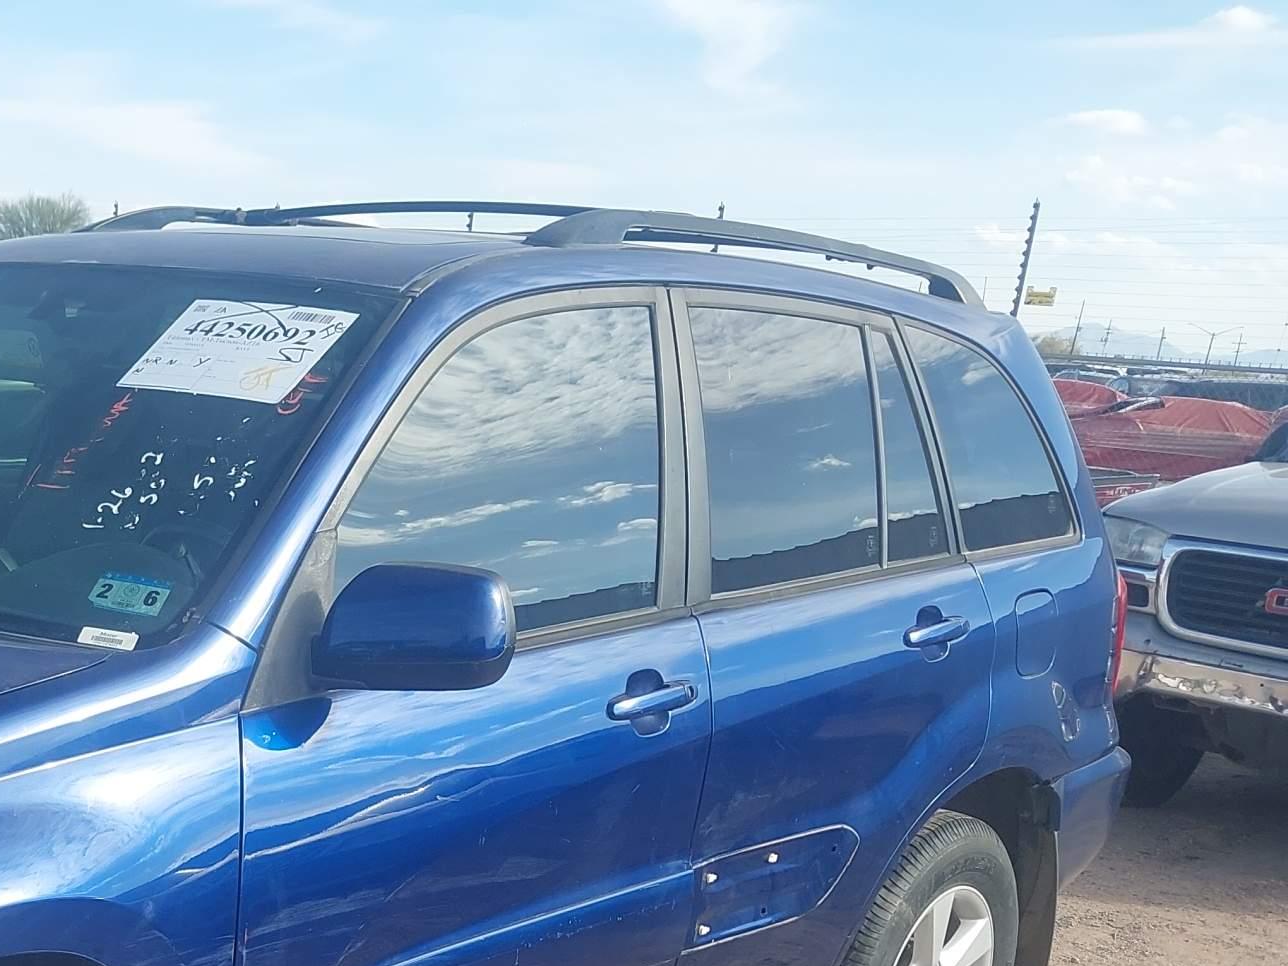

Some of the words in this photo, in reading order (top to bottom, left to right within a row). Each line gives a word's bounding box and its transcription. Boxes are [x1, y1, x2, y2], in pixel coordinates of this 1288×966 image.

[184, 319, 316, 346] 44250692
[95, 583, 114, 599] 2
[143, 590, 161, 607] 6
